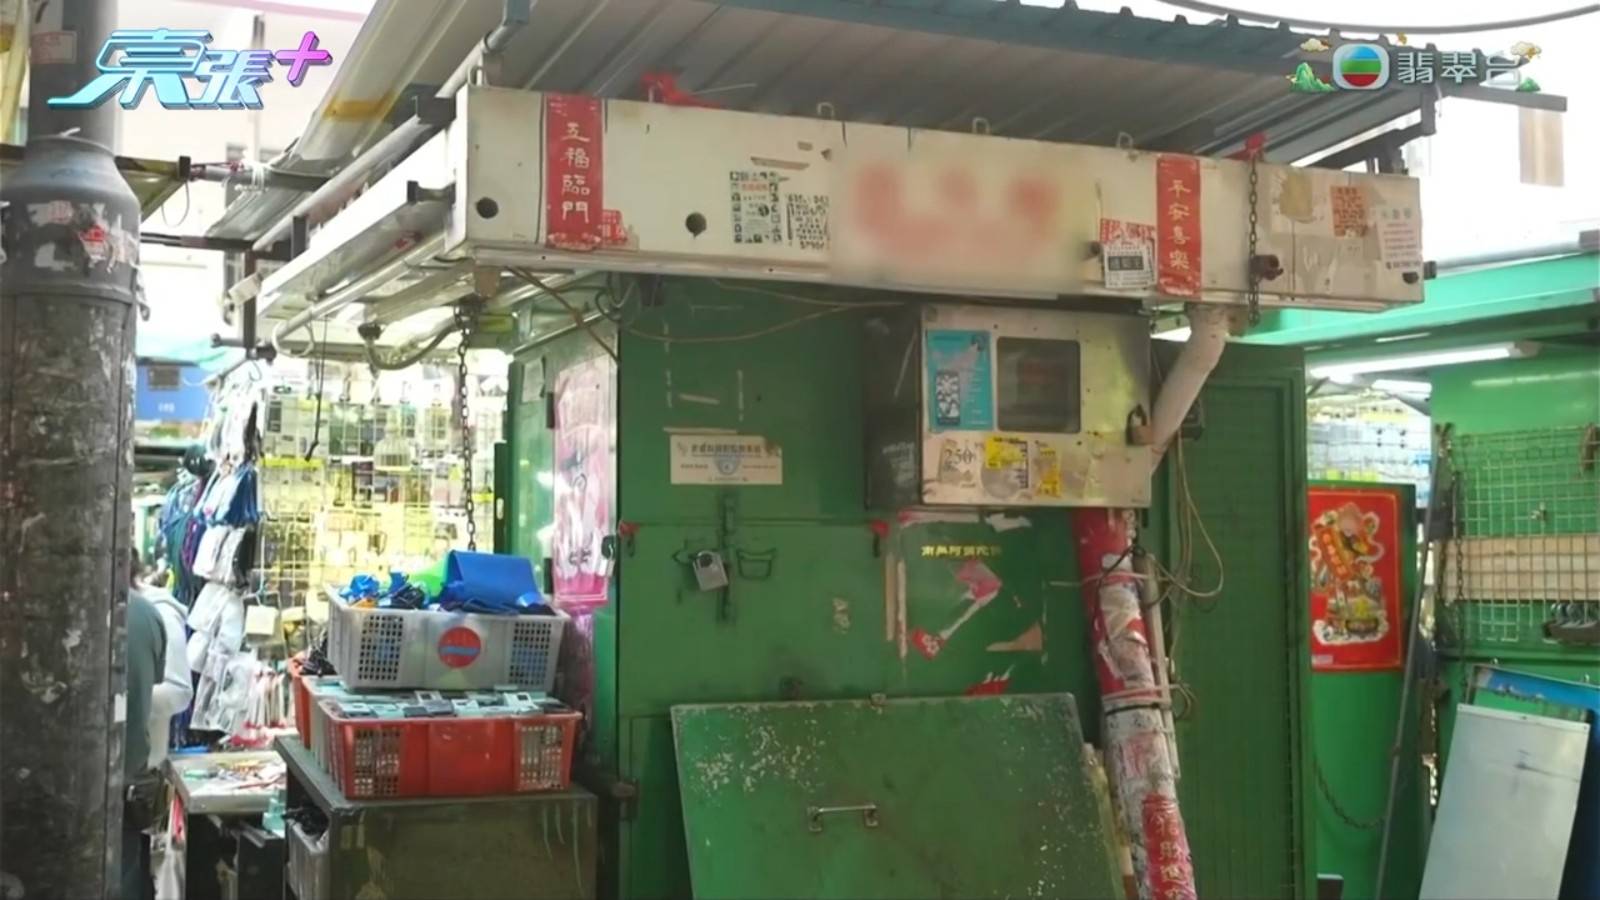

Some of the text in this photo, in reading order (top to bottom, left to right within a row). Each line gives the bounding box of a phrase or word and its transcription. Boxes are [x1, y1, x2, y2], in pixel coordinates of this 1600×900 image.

[560, 121, 591, 223] 五福臨門
[1167, 179, 1192, 270] 平安喜樂
